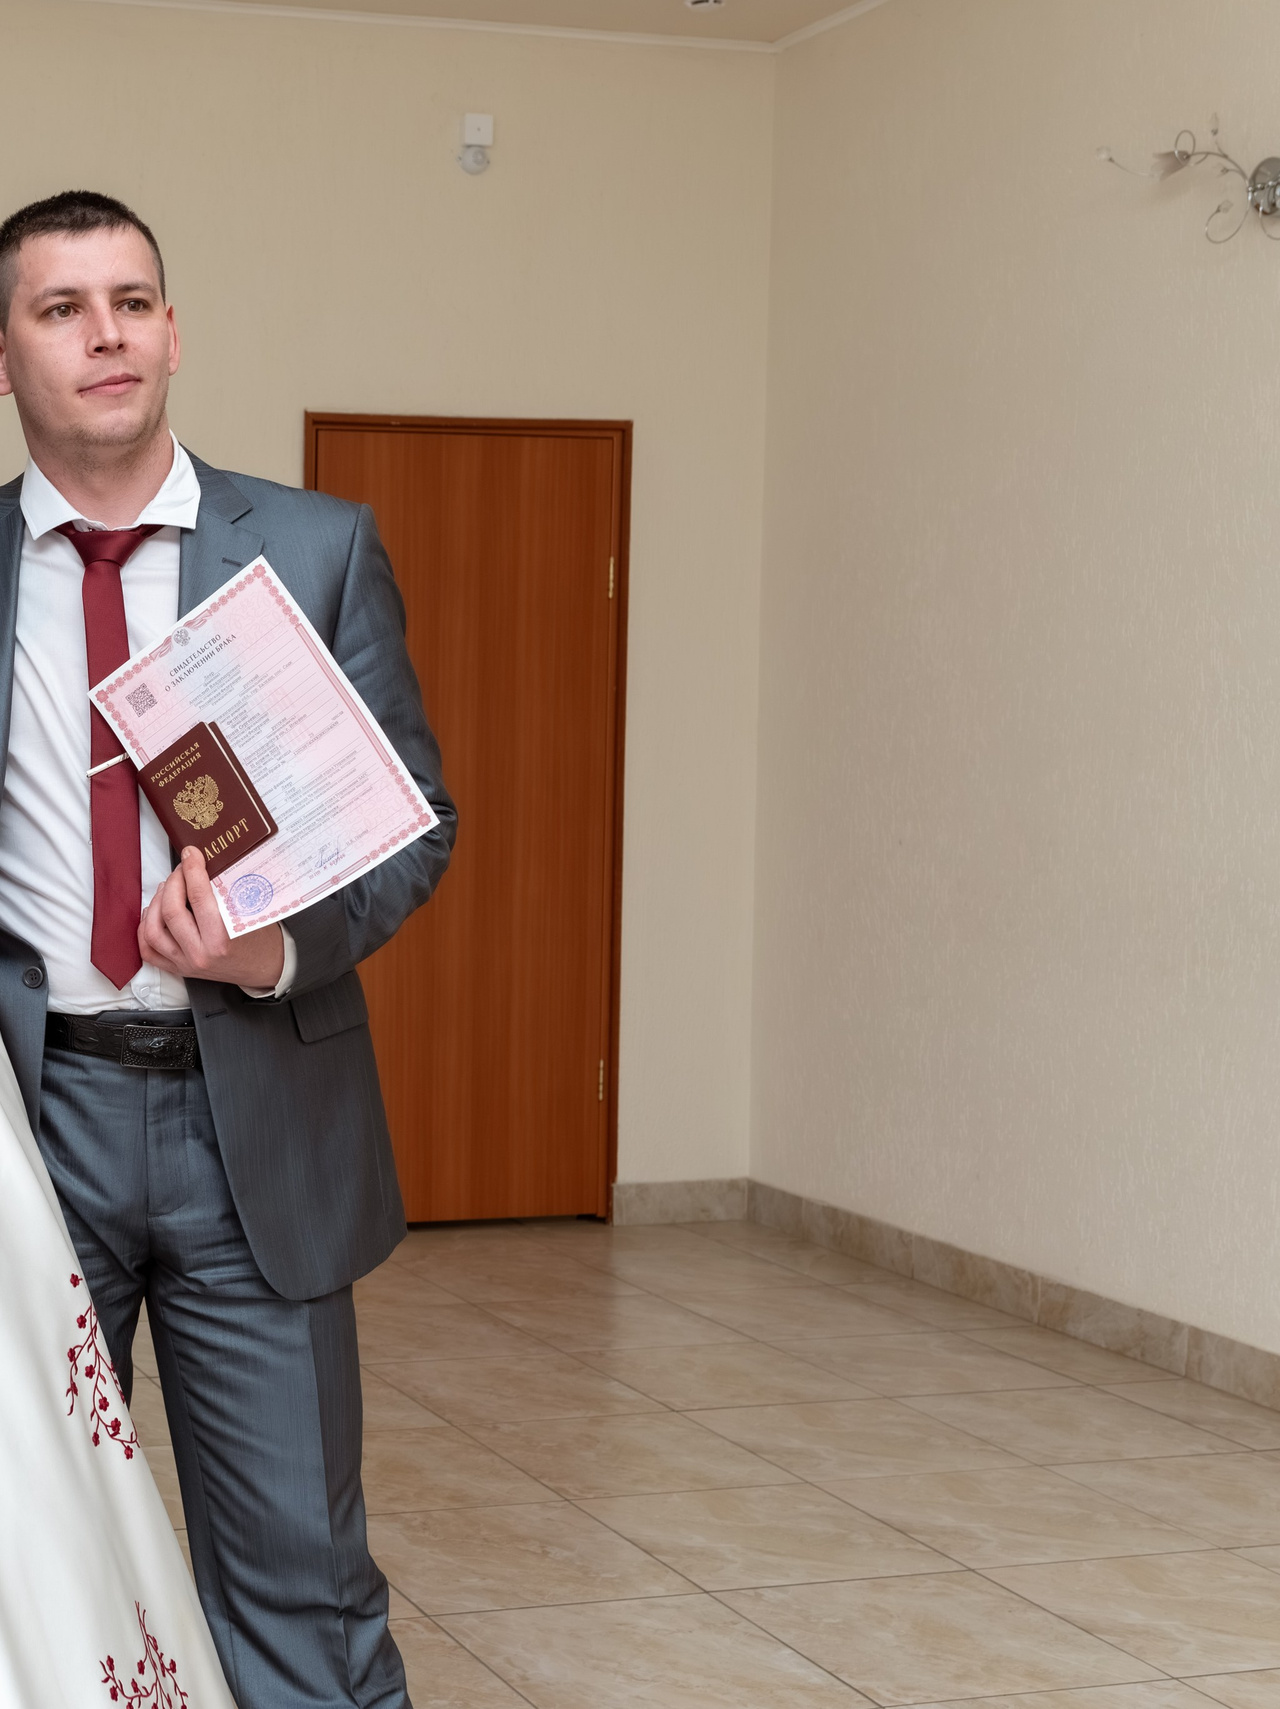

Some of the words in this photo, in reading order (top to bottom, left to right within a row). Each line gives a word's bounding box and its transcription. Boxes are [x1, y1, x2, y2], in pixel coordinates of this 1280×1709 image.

[168, 633, 221, 677] СВИДЕТЕЛЬСТВО
[170, 650, 215, 687] ЗАКЛЮЧЕНИИ
[214, 633, 236, 652] БРАКА
[150, 741, 200, 782] РОССИЙСКАЯ
[157, 751, 202, 788] ФЕДЕРАЦИЯ
[201, 817, 251, 861] АСПОРТ
